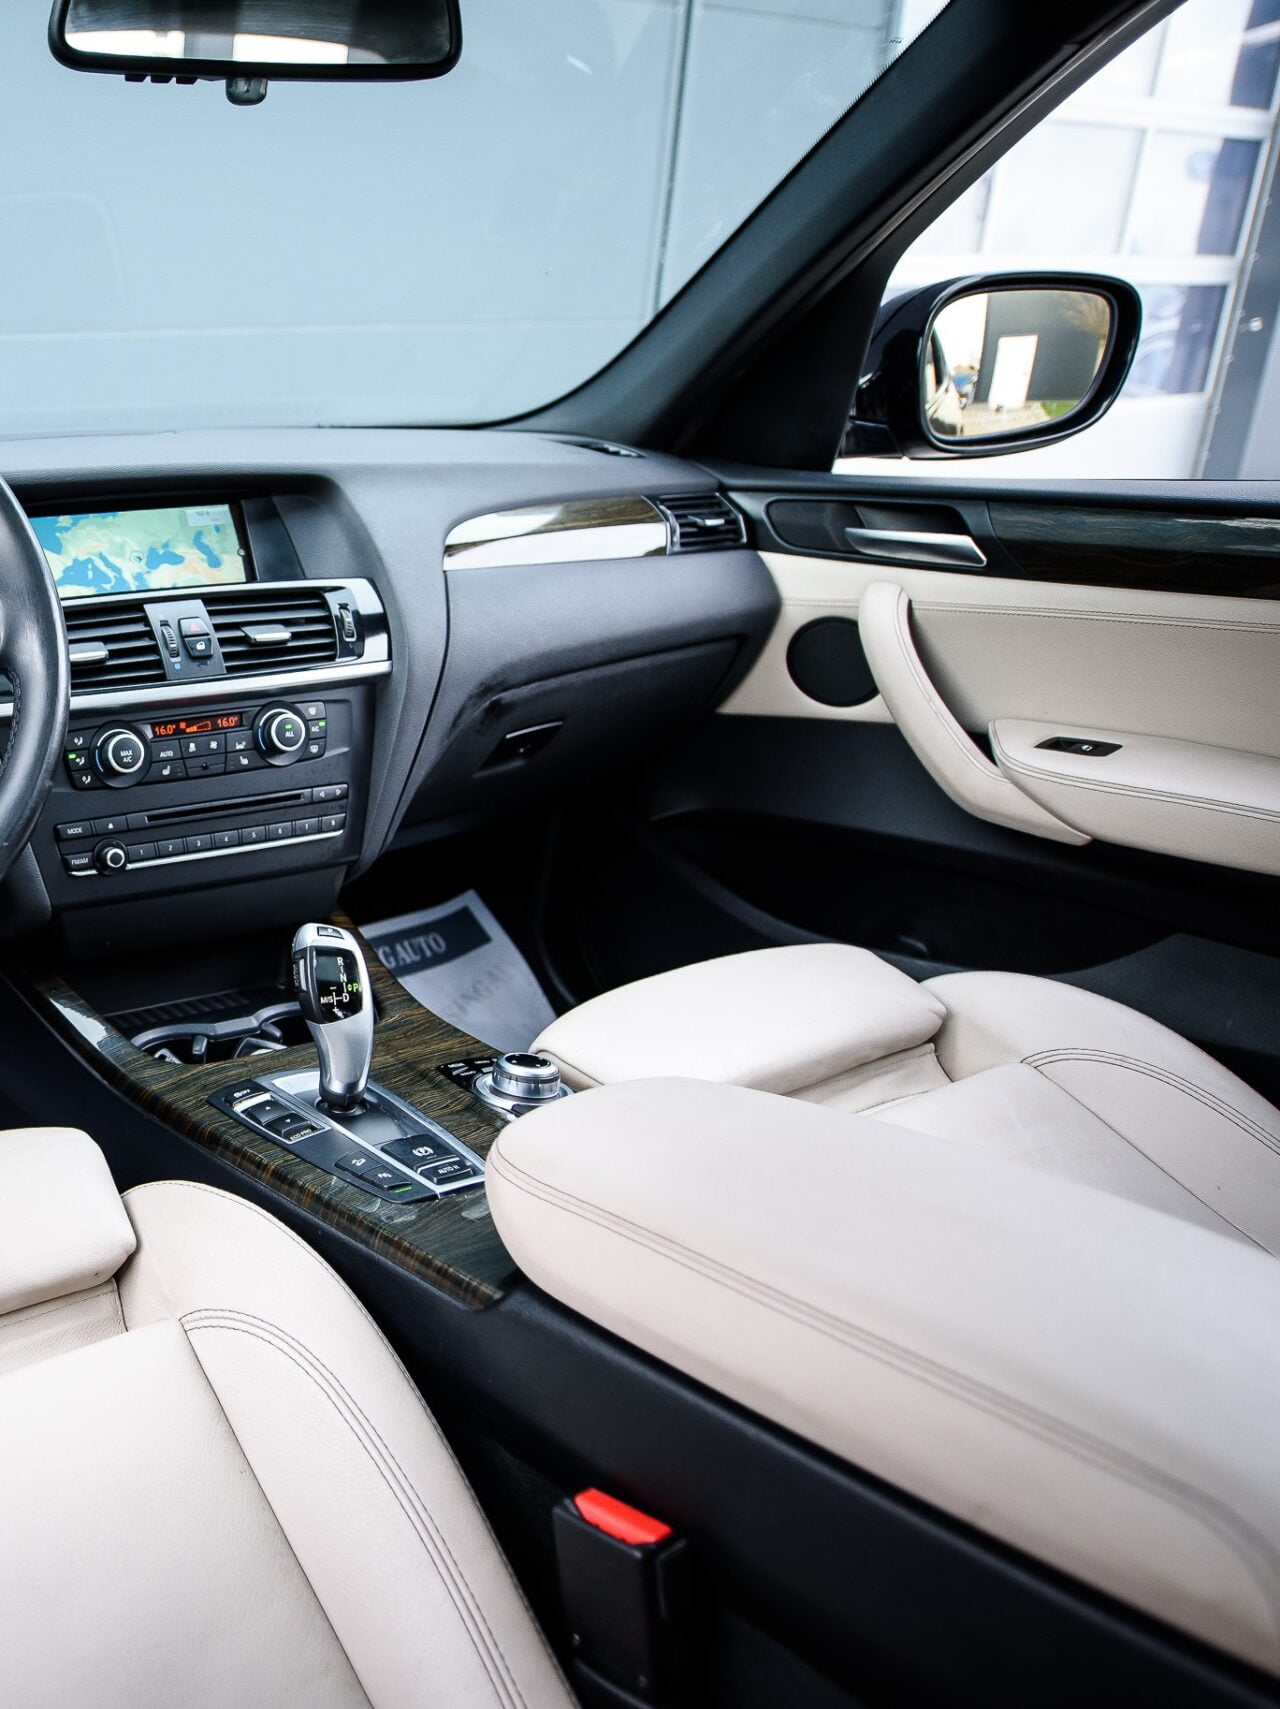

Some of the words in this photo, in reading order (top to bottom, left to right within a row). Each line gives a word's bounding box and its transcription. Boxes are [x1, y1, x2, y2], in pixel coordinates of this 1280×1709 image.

[120, 749, 133, 757] MAX
[160, 750, 173, 758] AUTO
[67, 827, 83, 835] MODE
[337, 957, 344, 965] R
[340, 973, 347, 982] N
[353, 983, 359, 992] P
[342, 993, 350, 1003] D
